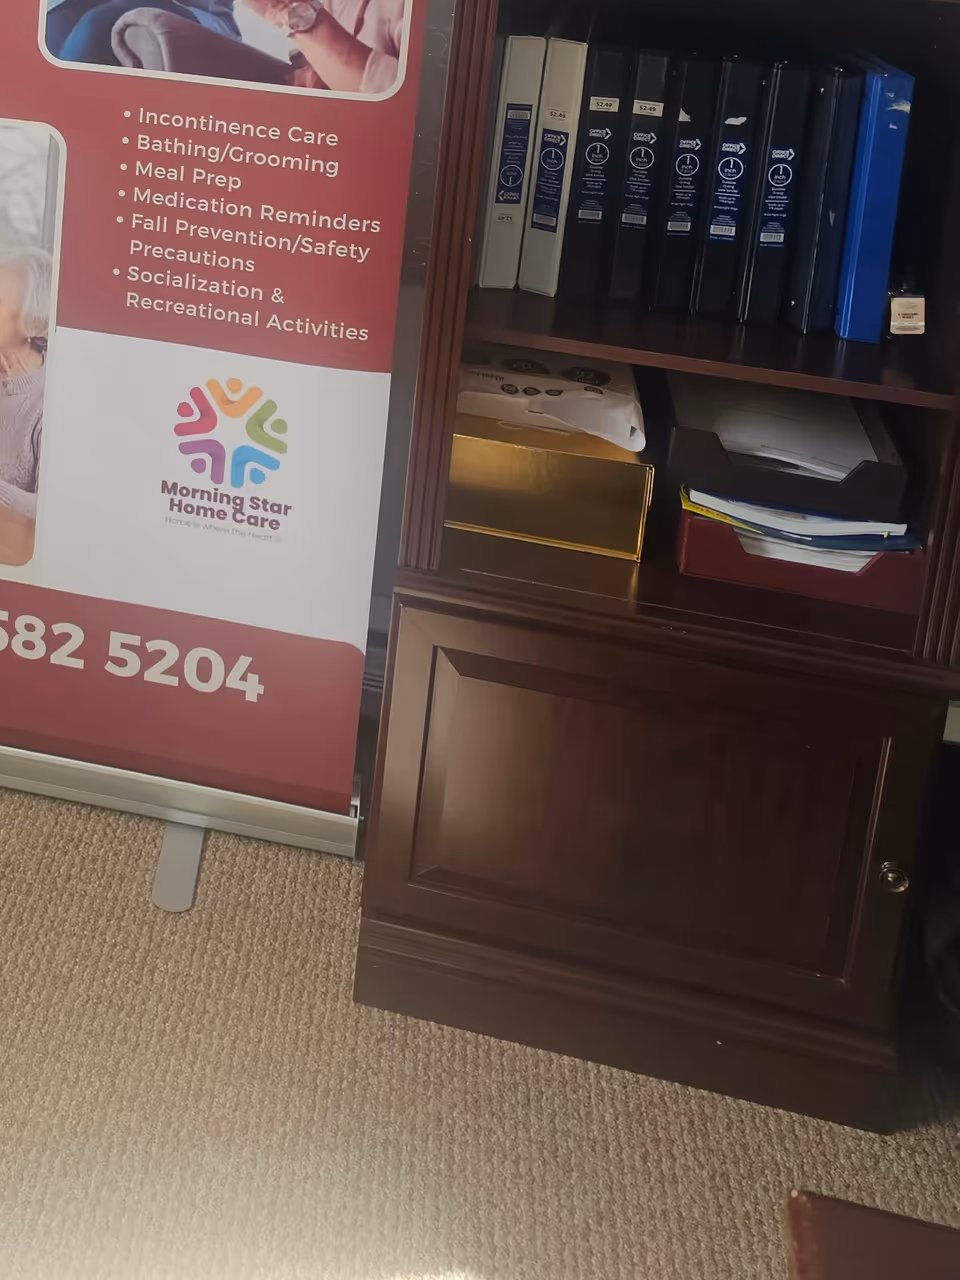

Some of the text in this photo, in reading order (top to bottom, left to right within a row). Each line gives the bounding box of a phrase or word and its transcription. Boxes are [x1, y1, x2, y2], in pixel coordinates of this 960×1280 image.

[138, 107, 339, 147] Incontinence Care
[135, 160, 242, 192] Meal Prep
[137, 134, 339, 178] Bathing/Grooming
[133, 187, 381, 233] Medication Reminders
[129, 239, 256, 272] Precautions
[131, 213, 371, 263] Fall Prevention/Safety
[127, 266, 285, 304] Socialization &
[126, 291, 369, 341] Recreational Activities
[160, 479, 293, 517] Morning Star
[169, 497, 281, 531] Home Care
[104, 631, 265, 703] 5204
